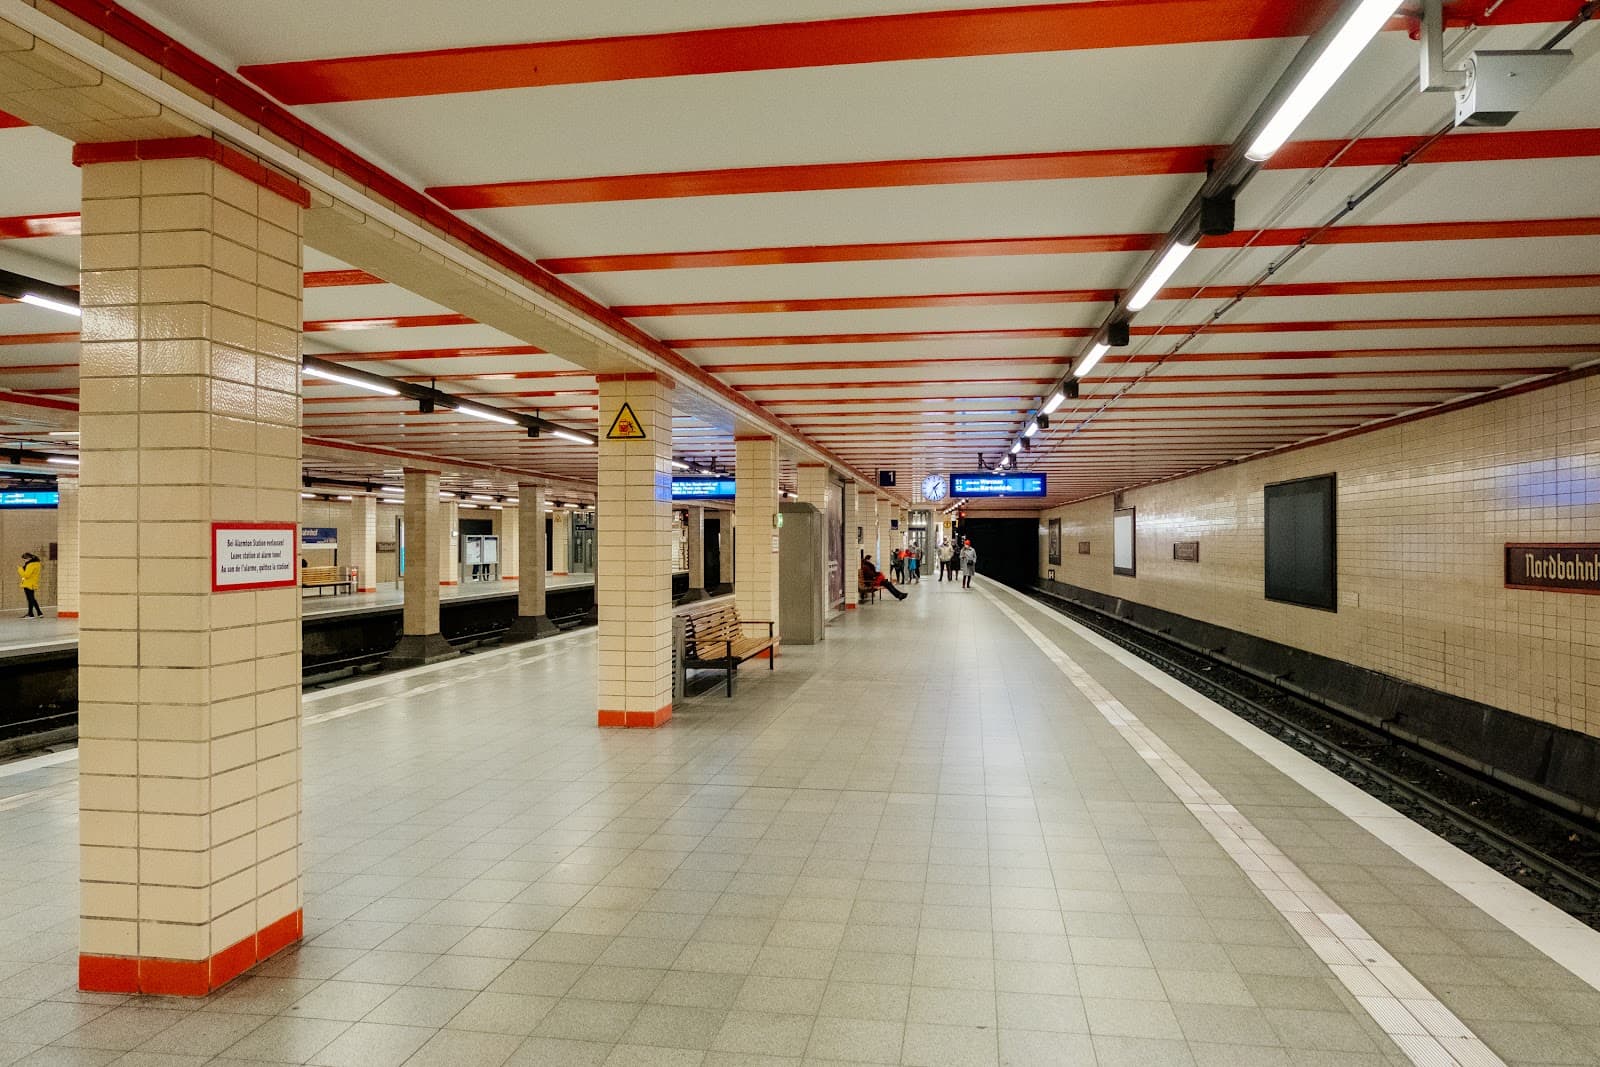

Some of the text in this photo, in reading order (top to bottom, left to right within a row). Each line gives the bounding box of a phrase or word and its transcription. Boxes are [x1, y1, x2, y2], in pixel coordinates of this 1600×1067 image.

[888, 471, 894, 482] 1
[252, 538, 266, 547] Station
[230, 551, 242, 560] Leave
[242, 551, 256, 559] station
[256, 551, 261, 559] at
[261, 551, 271, 559] alarm
